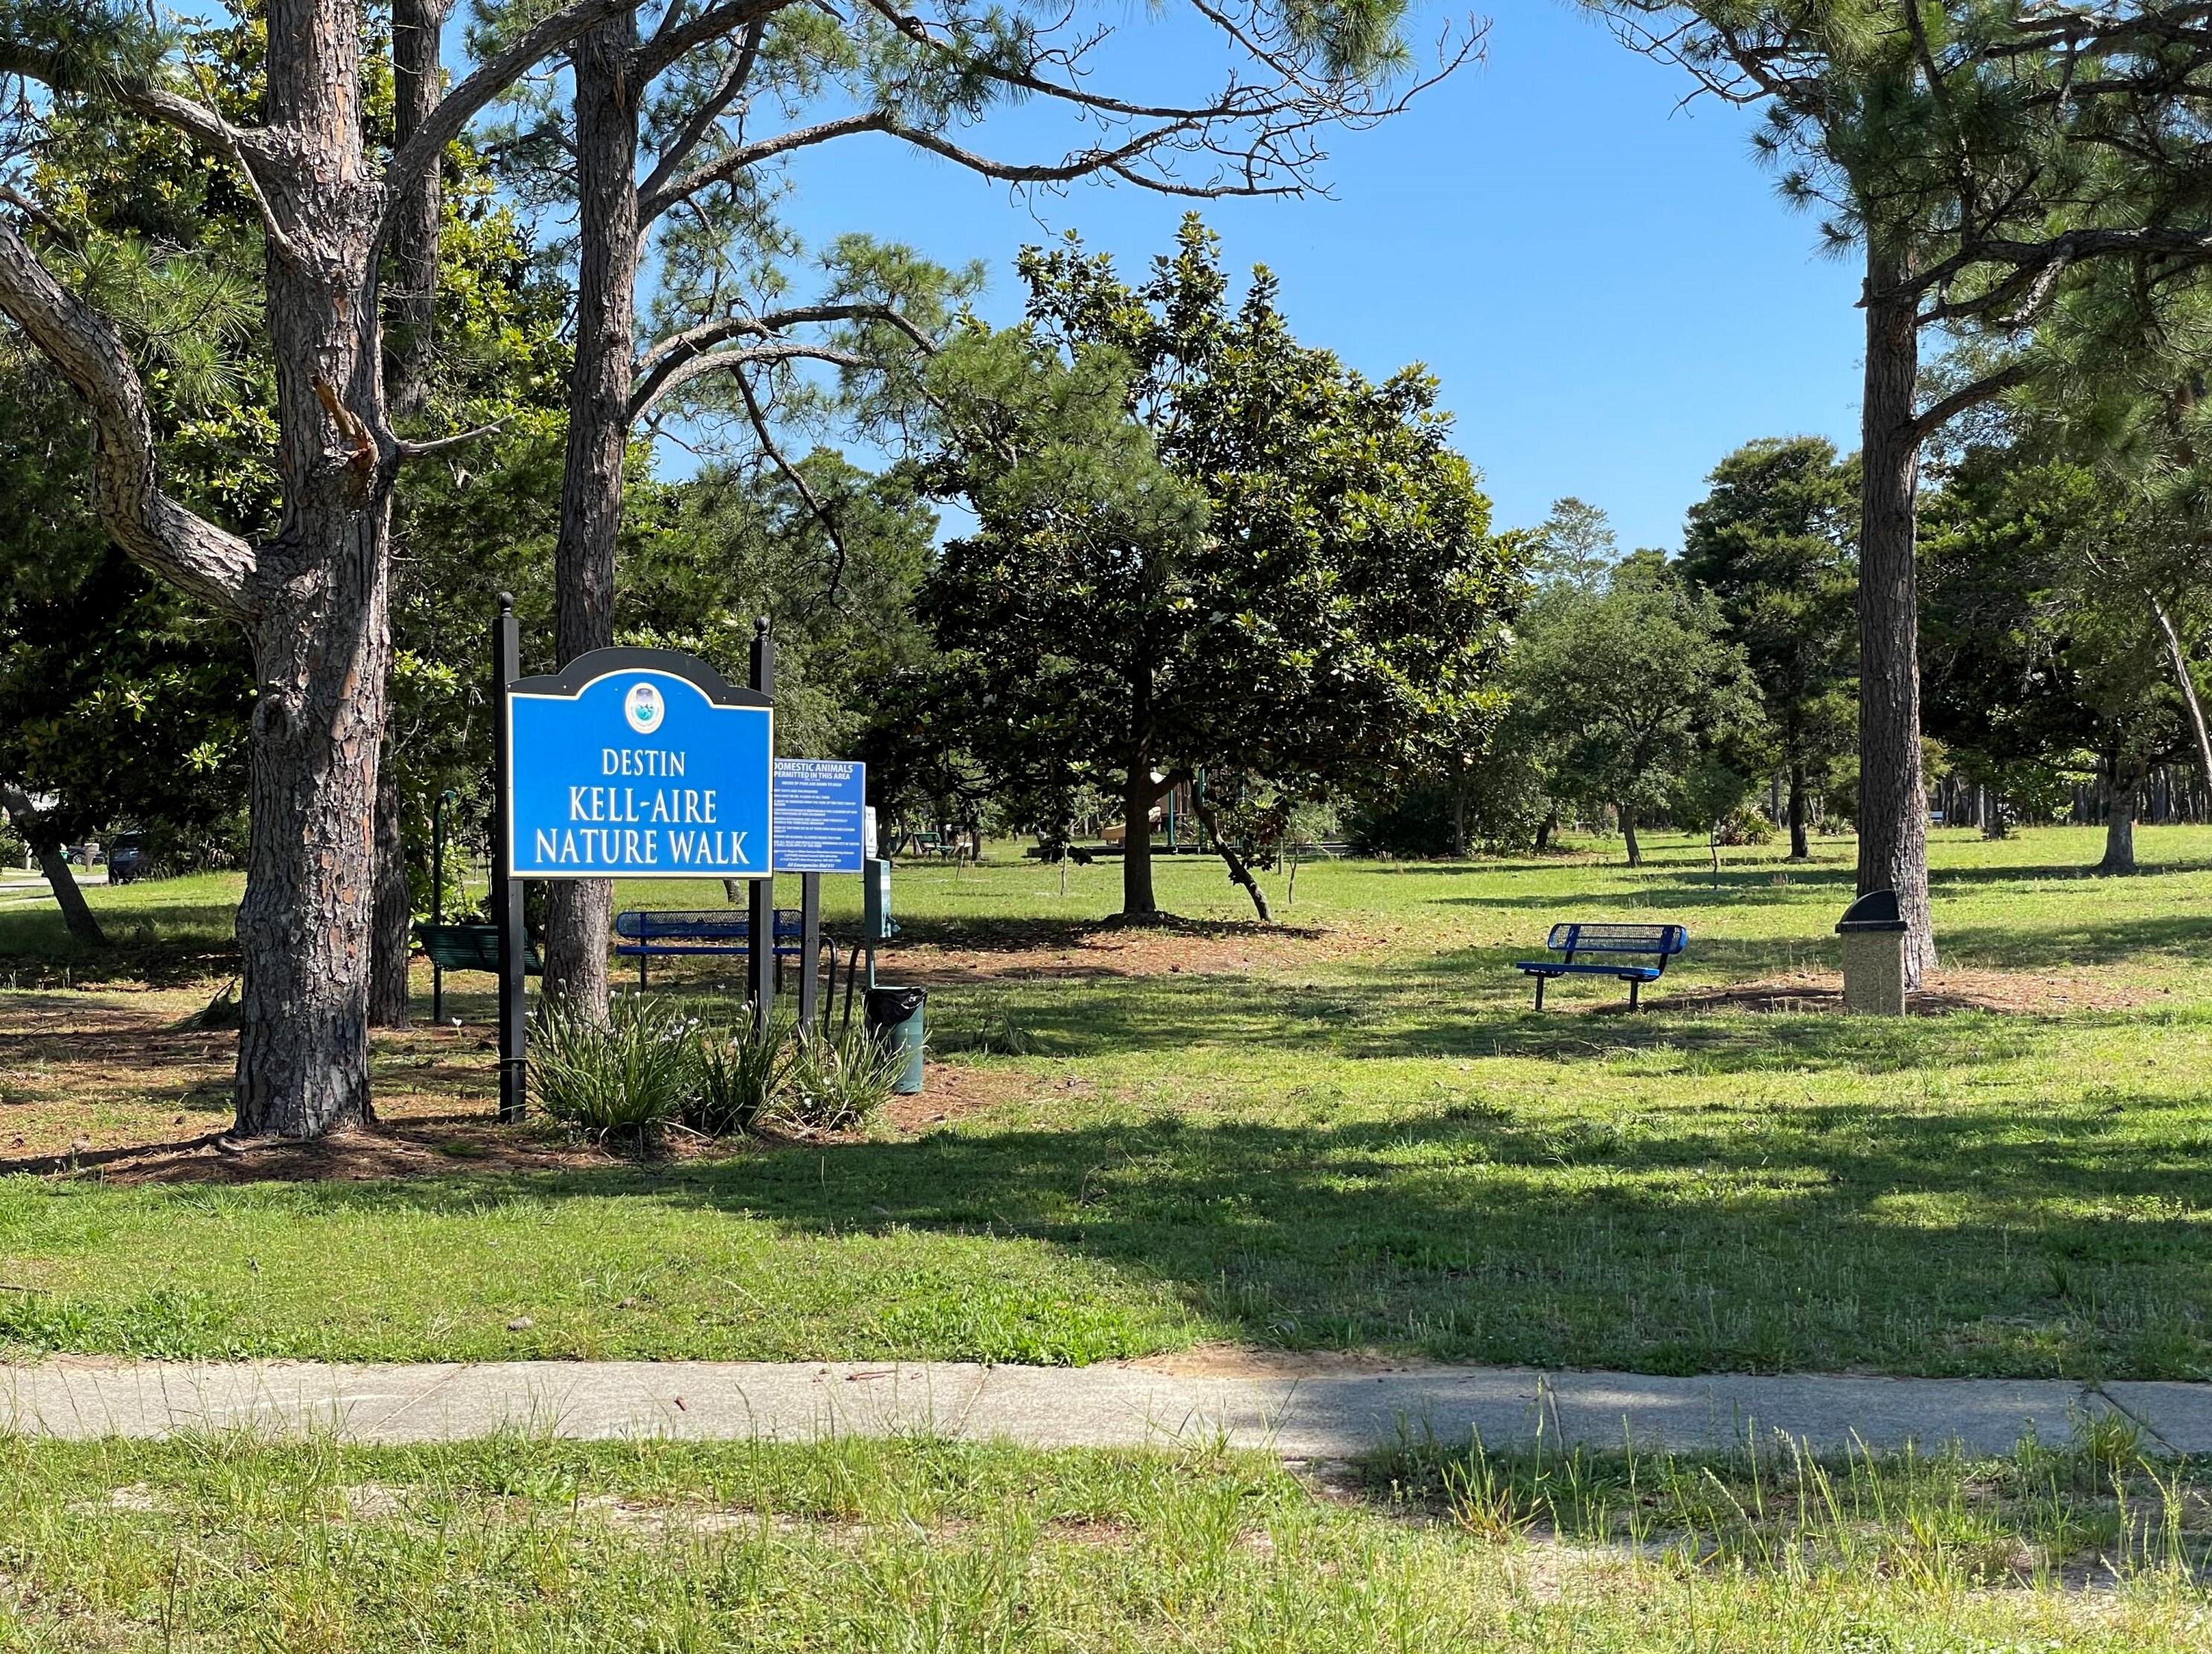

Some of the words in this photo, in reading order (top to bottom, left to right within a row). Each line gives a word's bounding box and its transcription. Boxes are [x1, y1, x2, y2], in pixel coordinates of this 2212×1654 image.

[602, 748, 685, 777] DESTIN
[774, 770, 809, 779] PERMITTED
[815, 764, 853, 773] ANIMALS
[569, 786, 717, 823] KELL-AIRE
[534, 827, 658, 864] NATURE
[668, 830, 750, 865] WALK
